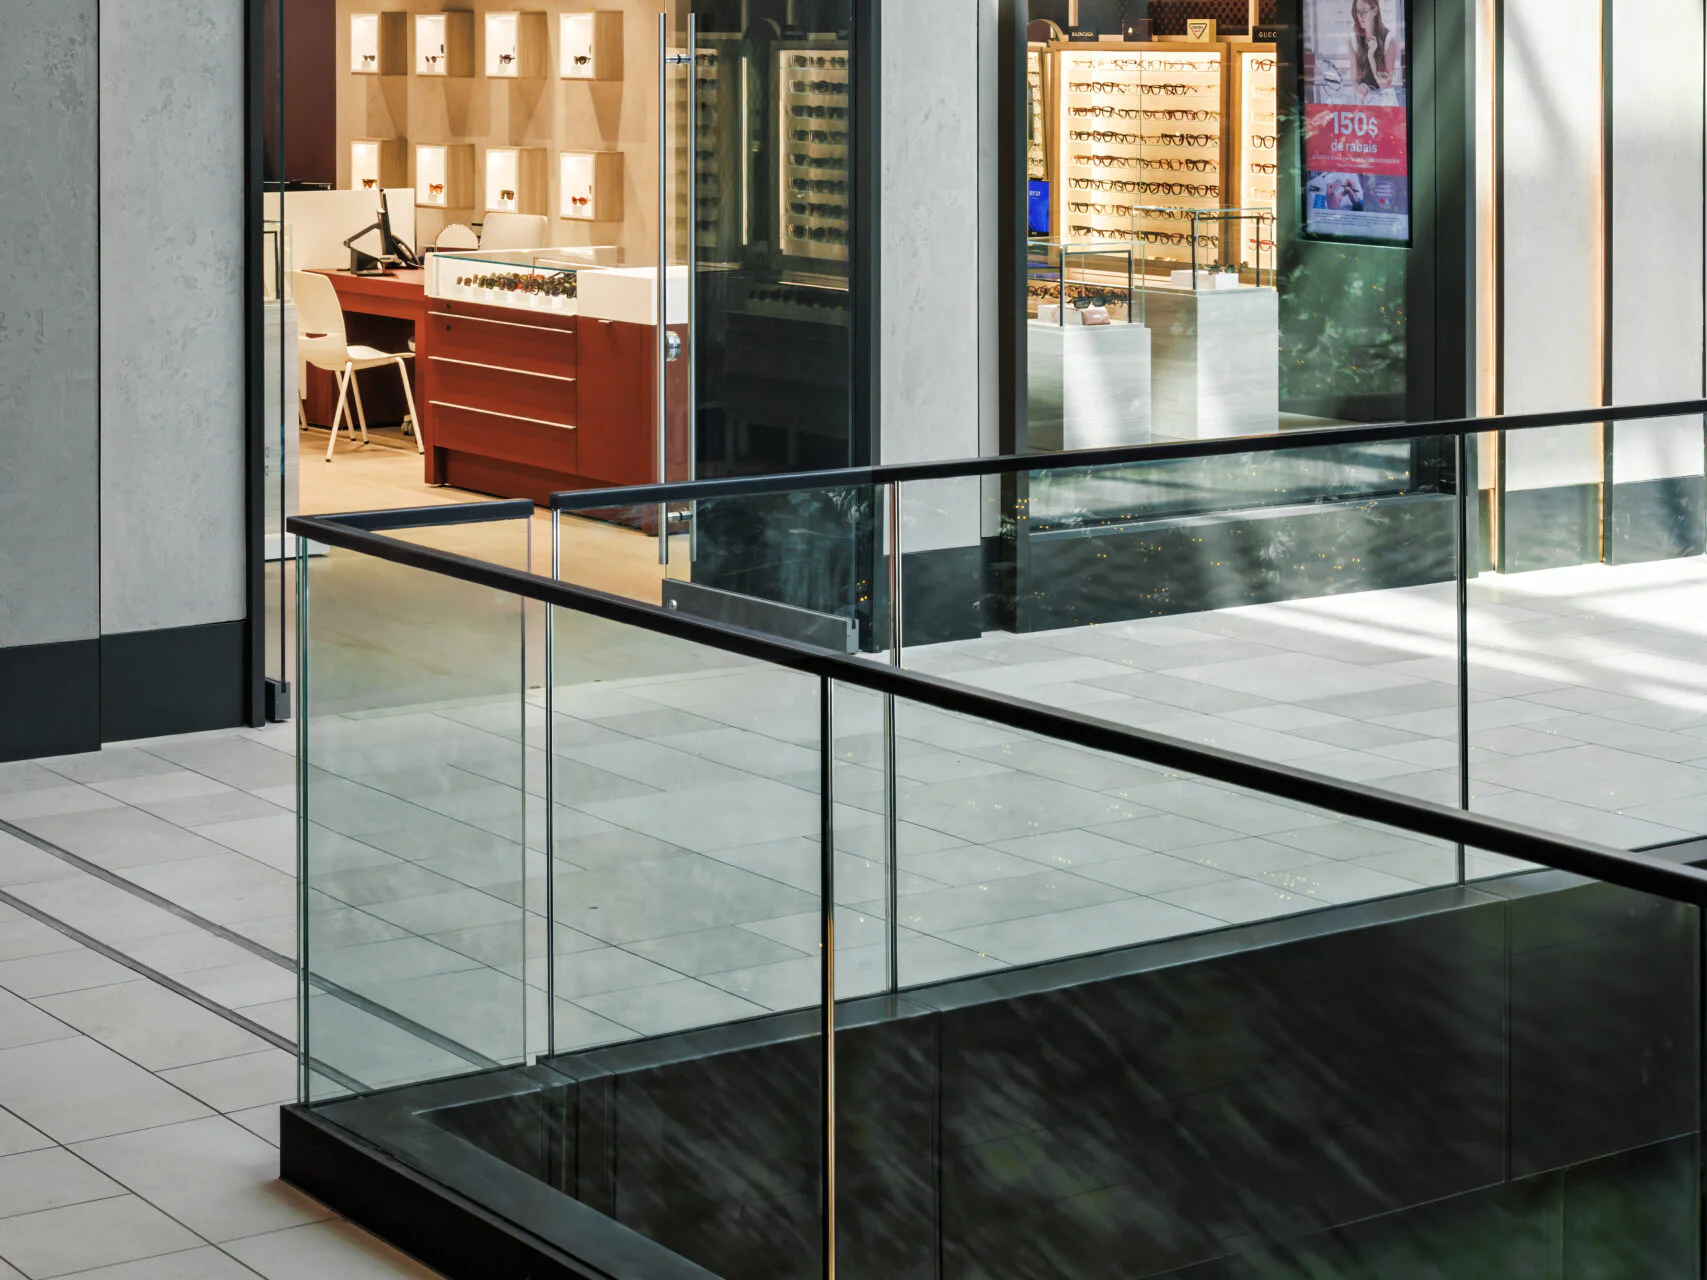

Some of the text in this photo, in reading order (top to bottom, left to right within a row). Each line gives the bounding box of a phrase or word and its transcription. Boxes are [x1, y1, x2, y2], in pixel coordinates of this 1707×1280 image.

[1330, 111, 1378, 138] 150$
[1331, 139, 1378, 153] de rabais
